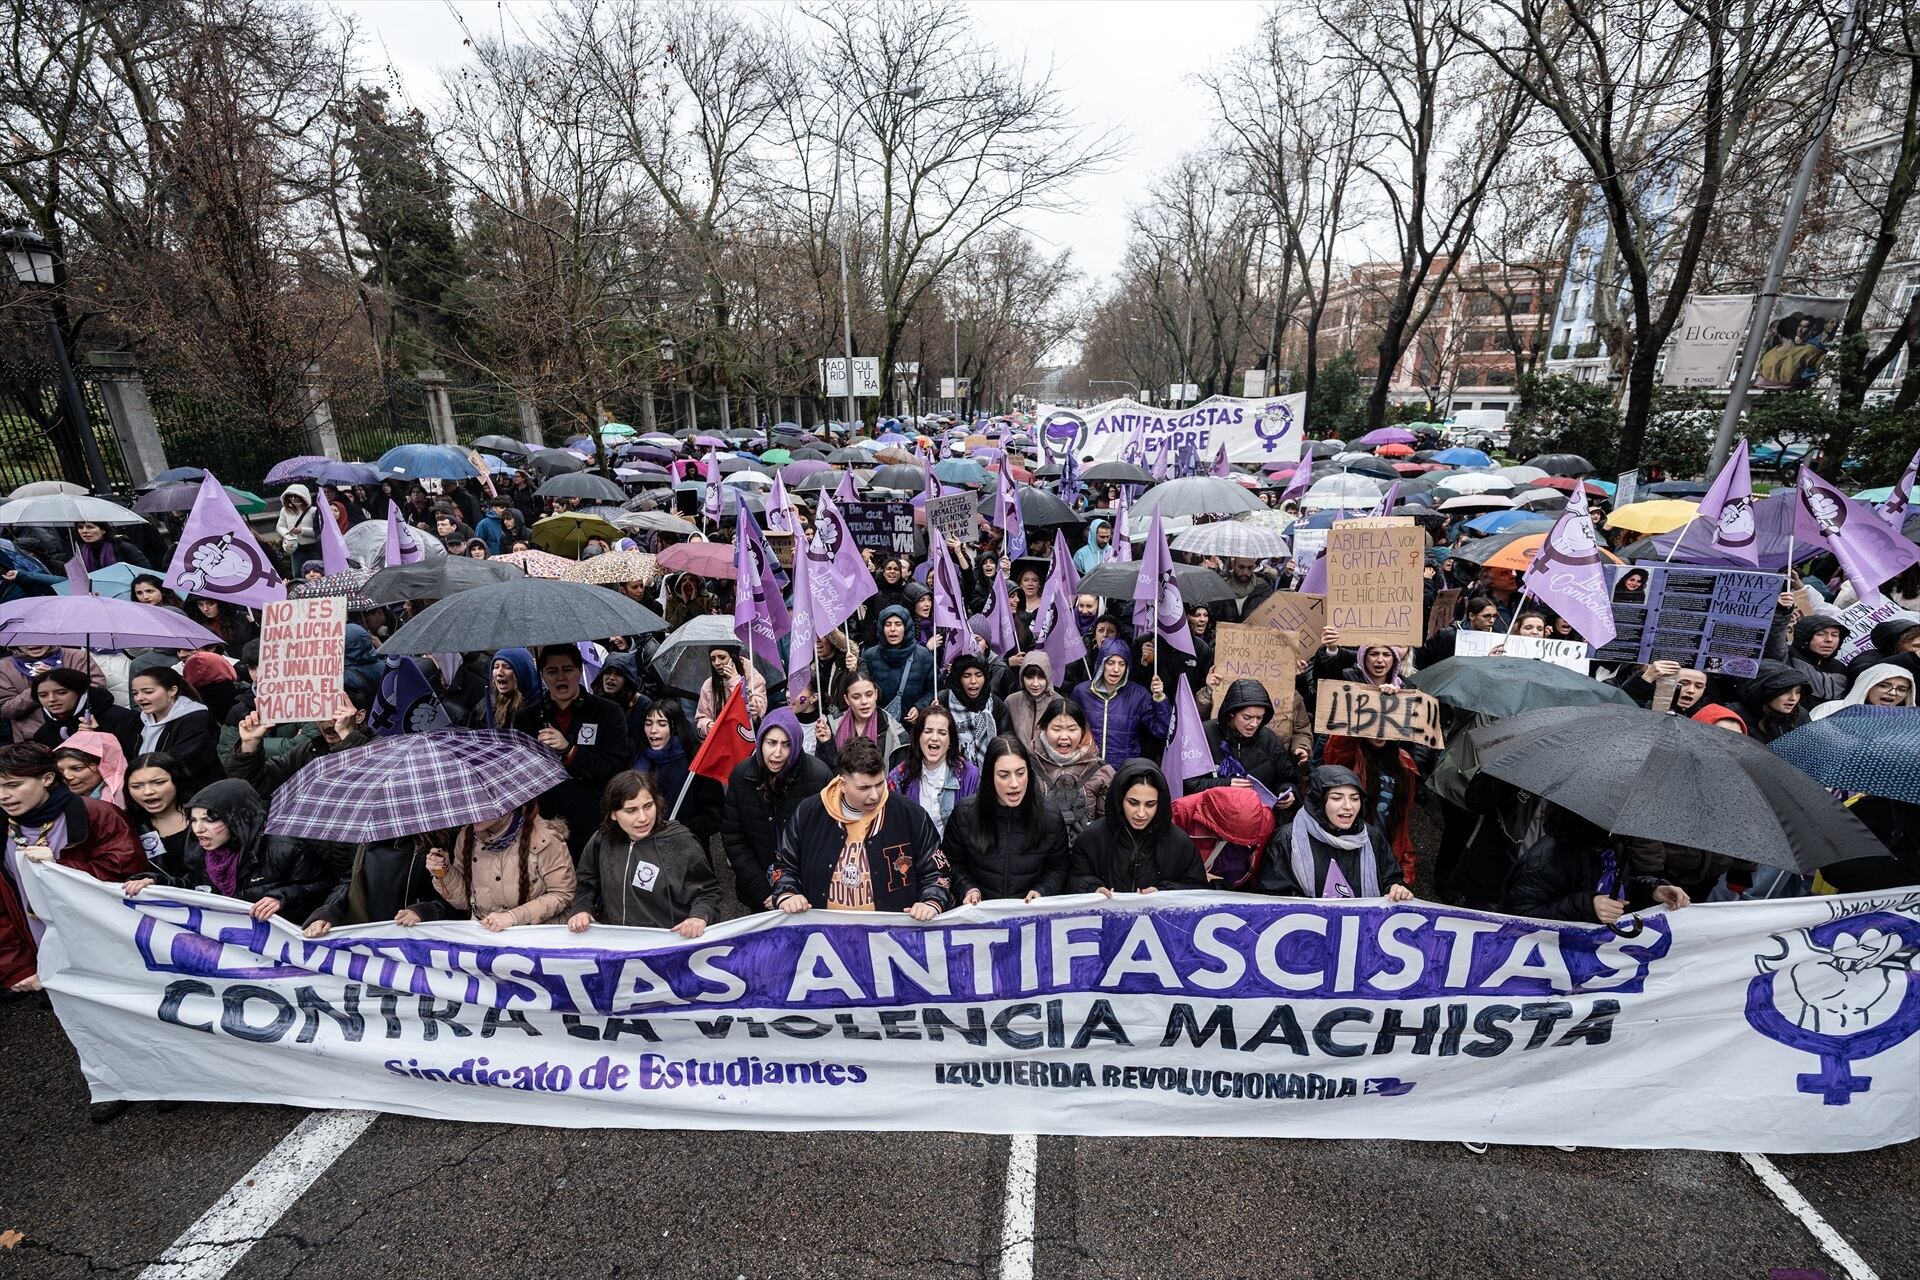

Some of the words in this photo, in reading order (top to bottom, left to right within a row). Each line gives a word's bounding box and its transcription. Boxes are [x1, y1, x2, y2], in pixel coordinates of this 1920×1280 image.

[1685, 326, 1700, 340] El
[1703, 326, 1740, 340] Greco
[830, 371, 846, 380] RID
[858, 371, 871, 379] TU
[854, 361, 873, 371] CUL
[864, 381, 879, 389] RA
[1094, 408, 1244, 435] ANTIFASCISTAS
[1144, 430, 1210, 452] EMPRE
[895, 515, 913, 532] PAZ
[892, 532, 914, 553] VIVA
[1332, 531, 1392, 552] ABUELA
[1399, 535, 1417, 548] VOY
[1330, 554, 1338, 564] A
[1342, 550, 1400, 570] GRITAR
[1331, 573, 1346, 587] LO
[1351, 572, 1373, 586] QUE
[1377, 571, 1386, 584] A
[1717, 572, 1764, 590] MAYKA
[1333, 588, 1350, 602] TE
[1356, 585, 1414, 603] HICIERON
[1717, 586, 1772, 605] PEREZ
[265, 603, 293, 626] NO
[307, 599, 333, 620] ES
[1333, 605, 1412, 628] CALLAR
[1712, 599, 1773, 619] MARQUEZ
[263, 625, 293, 642] UNA
[296, 621, 343, 639] LUCHA
[1223, 632, 1236, 644] SI
[262, 644, 280, 661] DE
[286, 639, 344, 658] MUJERES
[1222, 647, 1250, 658] SOMOS
[1259, 650, 1277, 660] LAS
[264, 661, 279, 679] ES
[283, 660, 310, 677] UNA
[312, 657, 344, 676] LUCHA
[259, 680, 314, 696] CONTRA
[320, 678, 339, 693] EL
[786, 912, 1665, 1002] ANTIFASCISTAS
[158, 979, 543, 1043] CONTRA
[674, 999, 1135, 1051] VIOLENCIA
[1159, 1000, 1621, 1059] MACHISTA
[384, 1056, 571, 1093] Sindicato
[579, 1055, 631, 1091] de
[639, 1053, 868, 1091] Estudiantes
[935, 1060, 1097, 1089] IZQUIERDA
[1102, 1063, 1358, 1101] REVOLUCIONARIA
